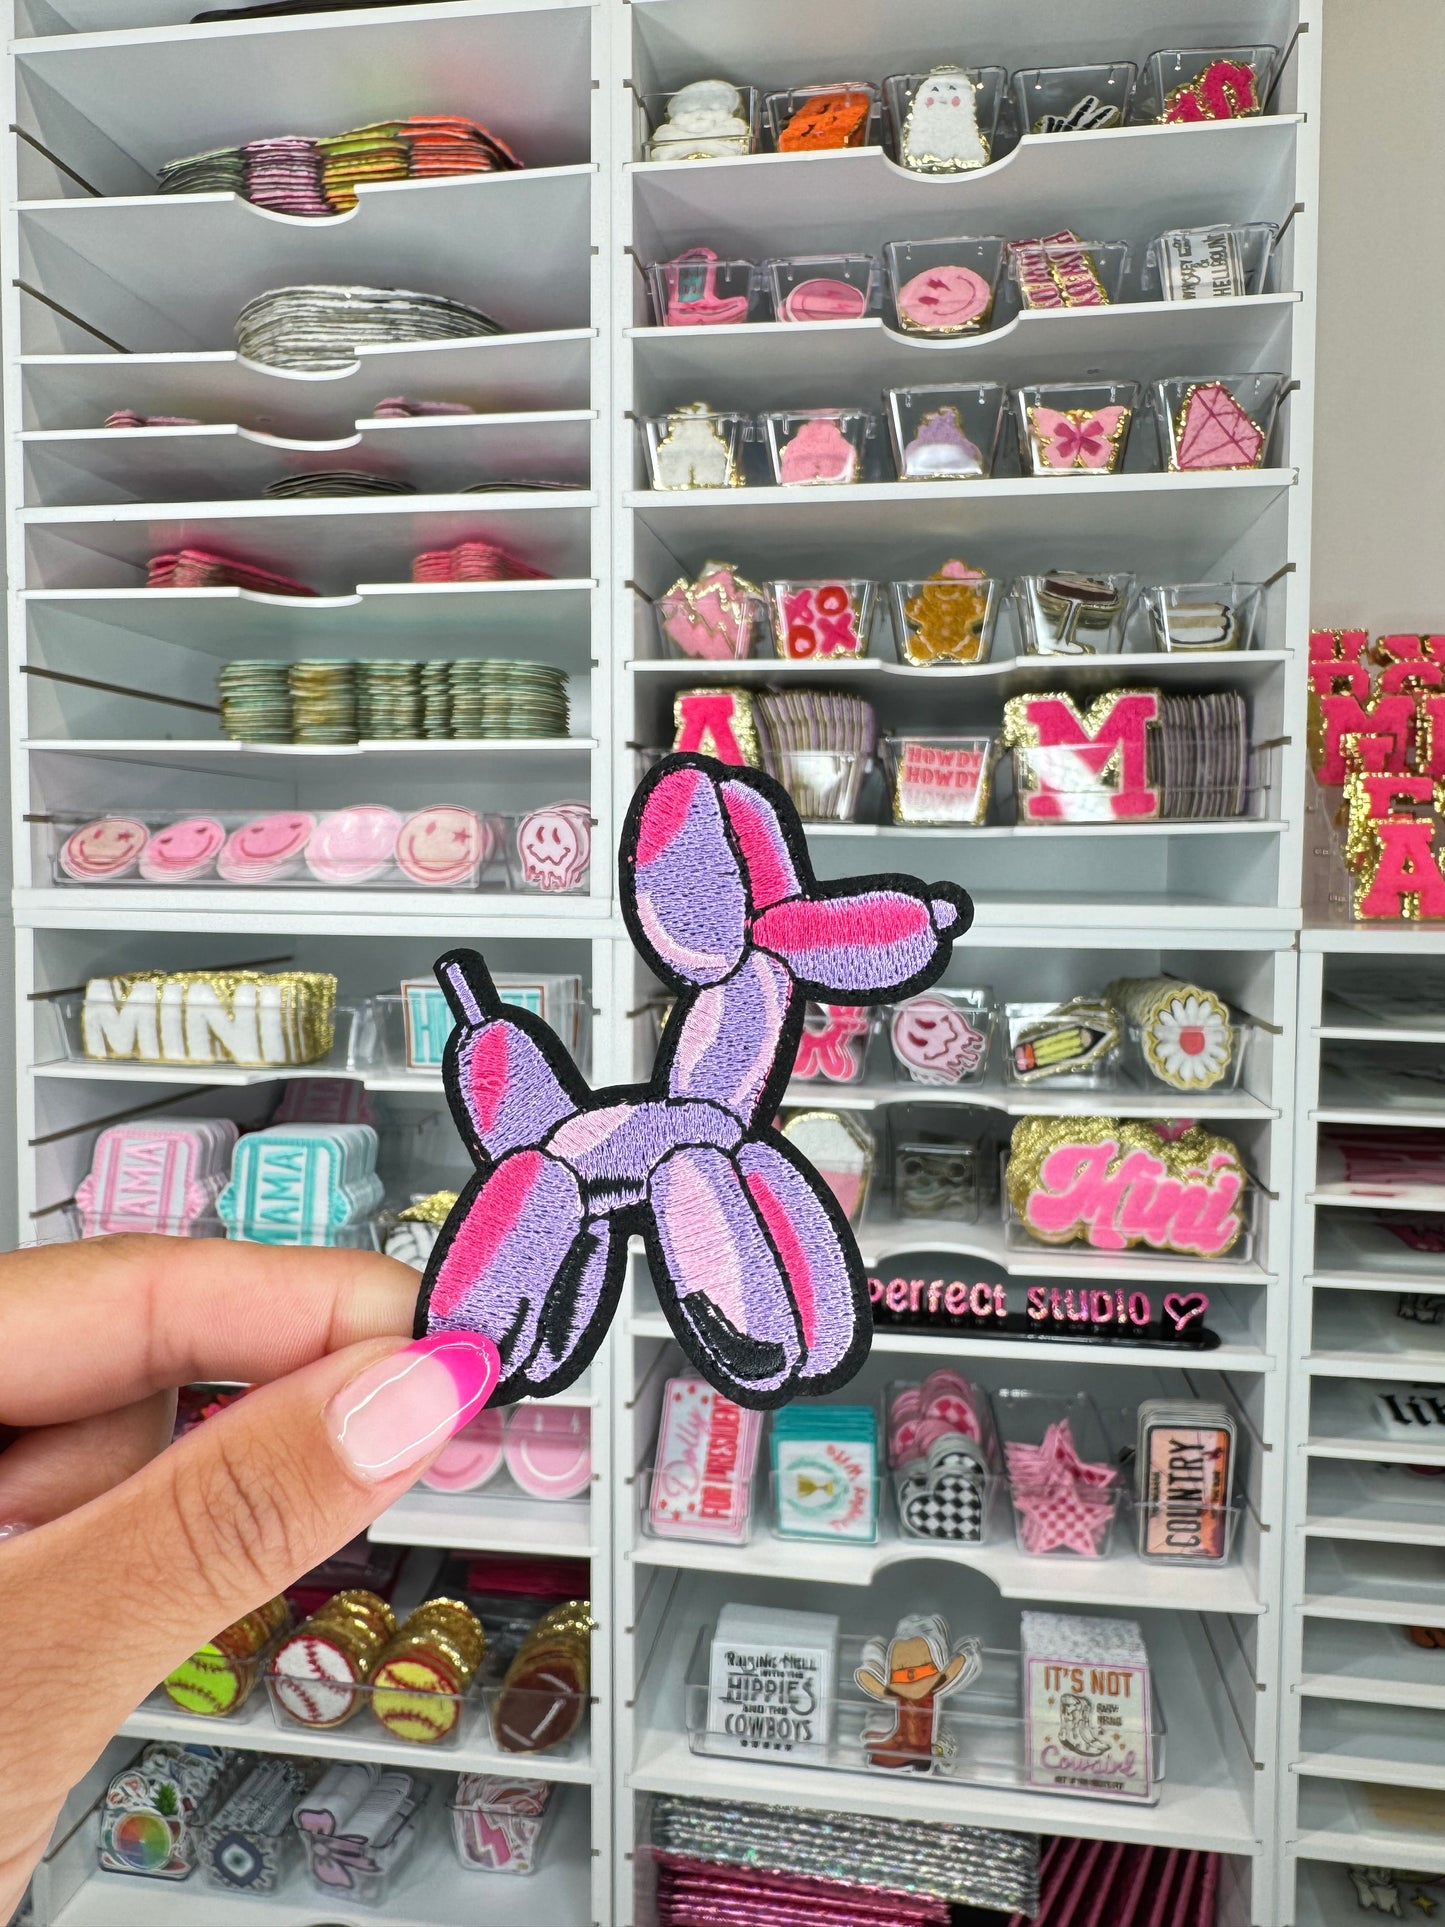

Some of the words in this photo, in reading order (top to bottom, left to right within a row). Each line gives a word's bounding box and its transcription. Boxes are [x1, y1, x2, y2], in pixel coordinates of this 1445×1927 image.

[905, 766, 980, 788] HOWDY
[908, 746, 981, 768] HOWDY
[1025, 696, 1157, 817] M
[83, 978, 287, 1065] MINI
[1028, 1139, 1241, 1251] Mini
[663, 1408, 710, 1497] Dolly
[1165, 1438, 1205, 1547] COUNTRY
[727, 1677, 817, 1716] HIPPIES
[1044, 1665, 1084, 1694] IT'S
[1090, 1669, 1133, 1698] NOT
[725, 1713, 812, 1741] COWBOYS
